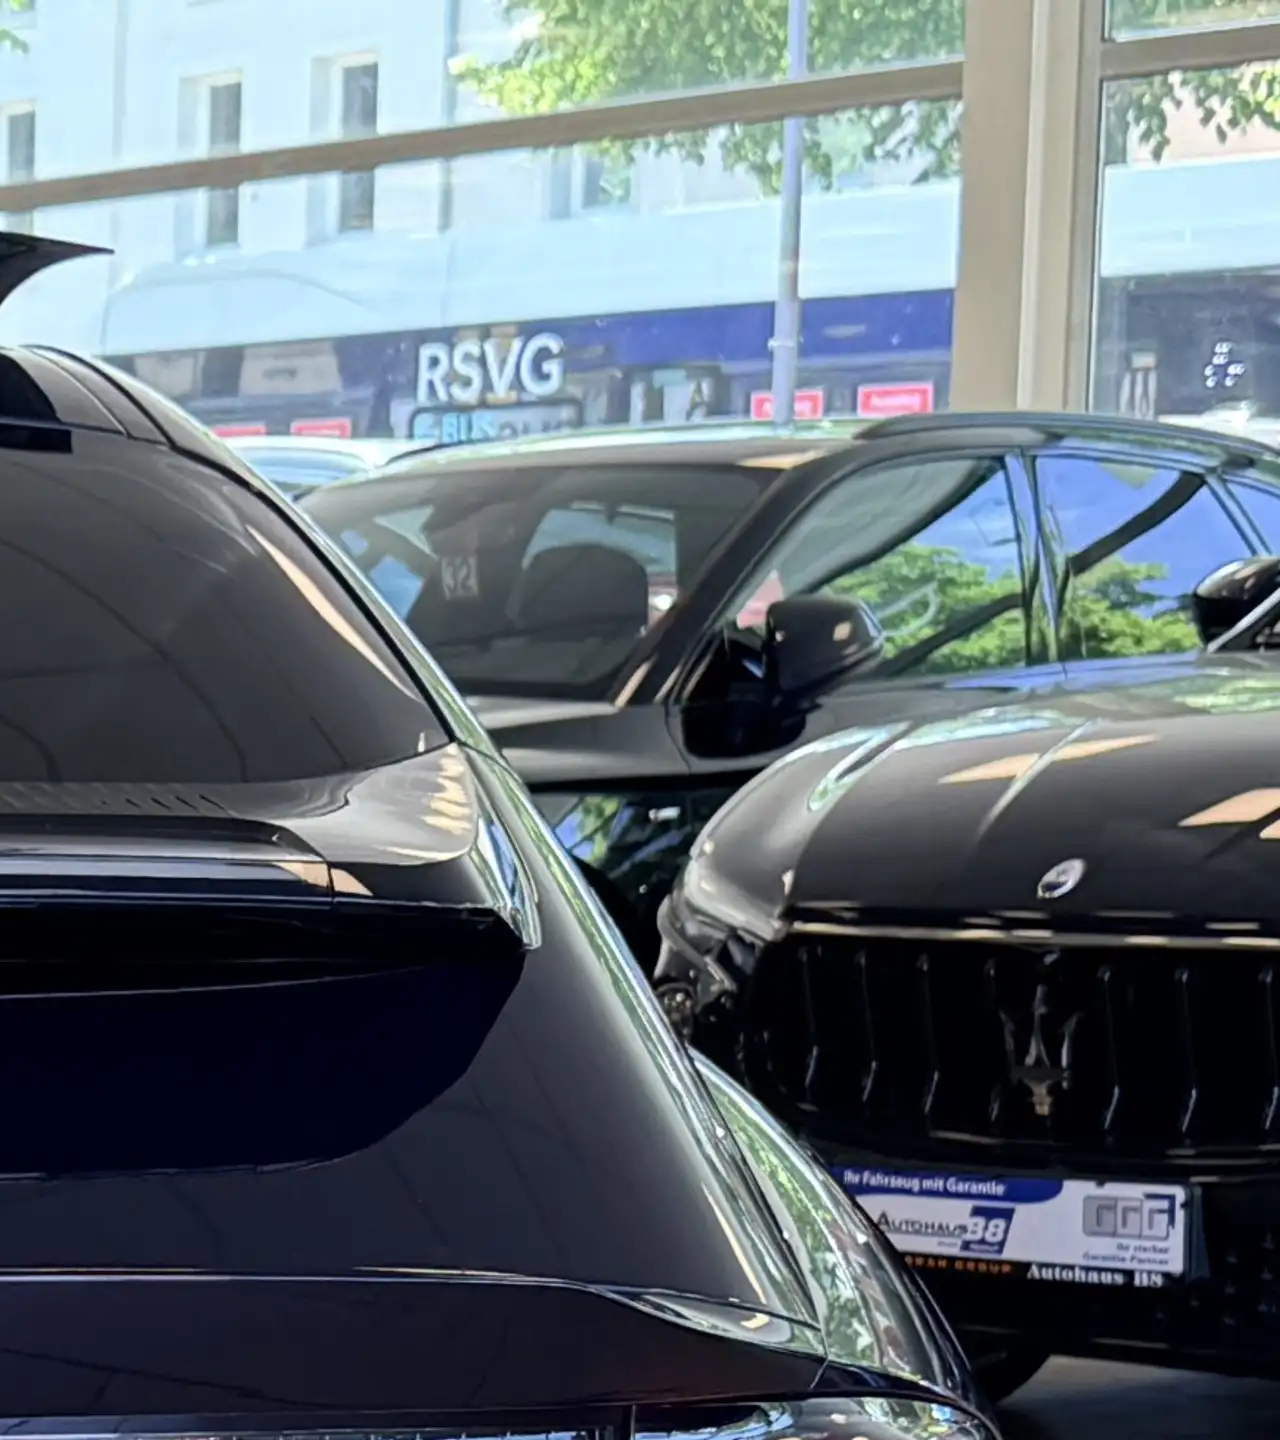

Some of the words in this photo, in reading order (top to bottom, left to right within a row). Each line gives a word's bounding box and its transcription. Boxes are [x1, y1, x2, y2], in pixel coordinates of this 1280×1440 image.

[416, 332, 565, 403] RSVG
[843, 1169, 860, 1185] Ihr
[862, 1169, 921, 1193] Fahrzeug
[922, 1174, 944, 1190] mit
[946, 1176, 1008, 1196] Garantie
[1027, 1263, 1124, 1285] Autohaus
